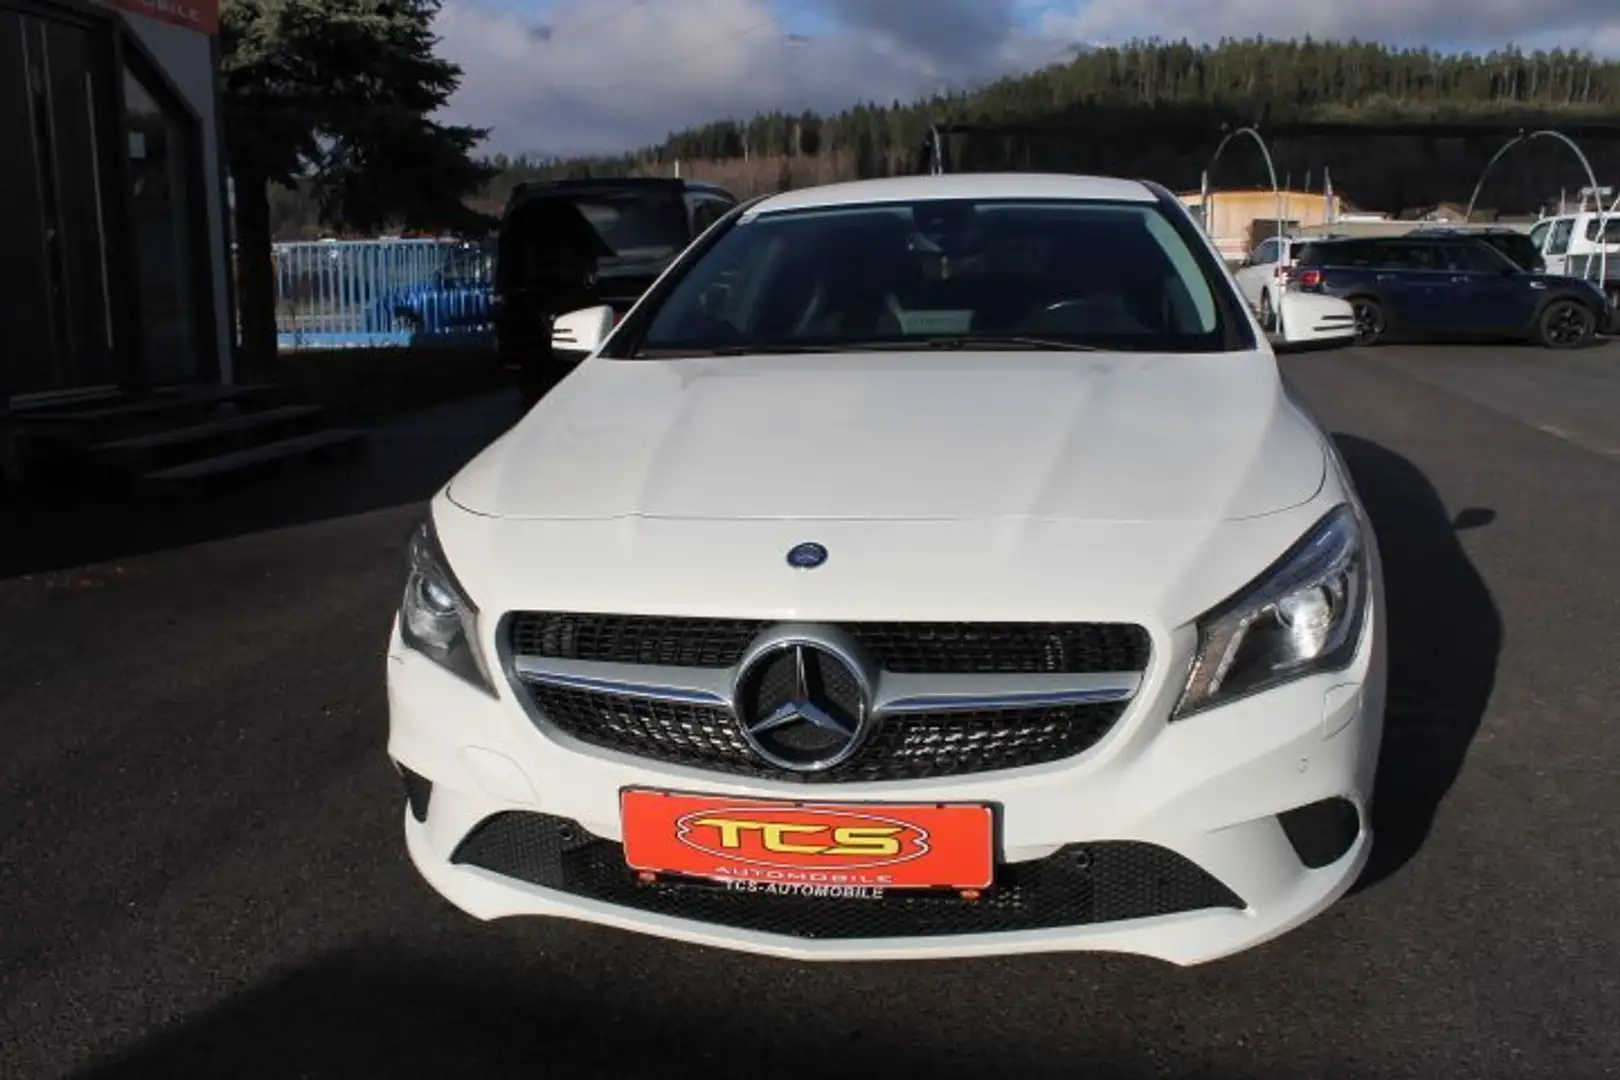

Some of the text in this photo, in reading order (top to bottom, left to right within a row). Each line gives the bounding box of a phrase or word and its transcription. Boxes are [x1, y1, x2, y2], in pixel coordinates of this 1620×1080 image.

[695, 818, 905, 855] TCS
[715, 866, 892, 884] AUTOMOBILE
[724, 880, 884, 899] TCS-AUTOMOBILE
